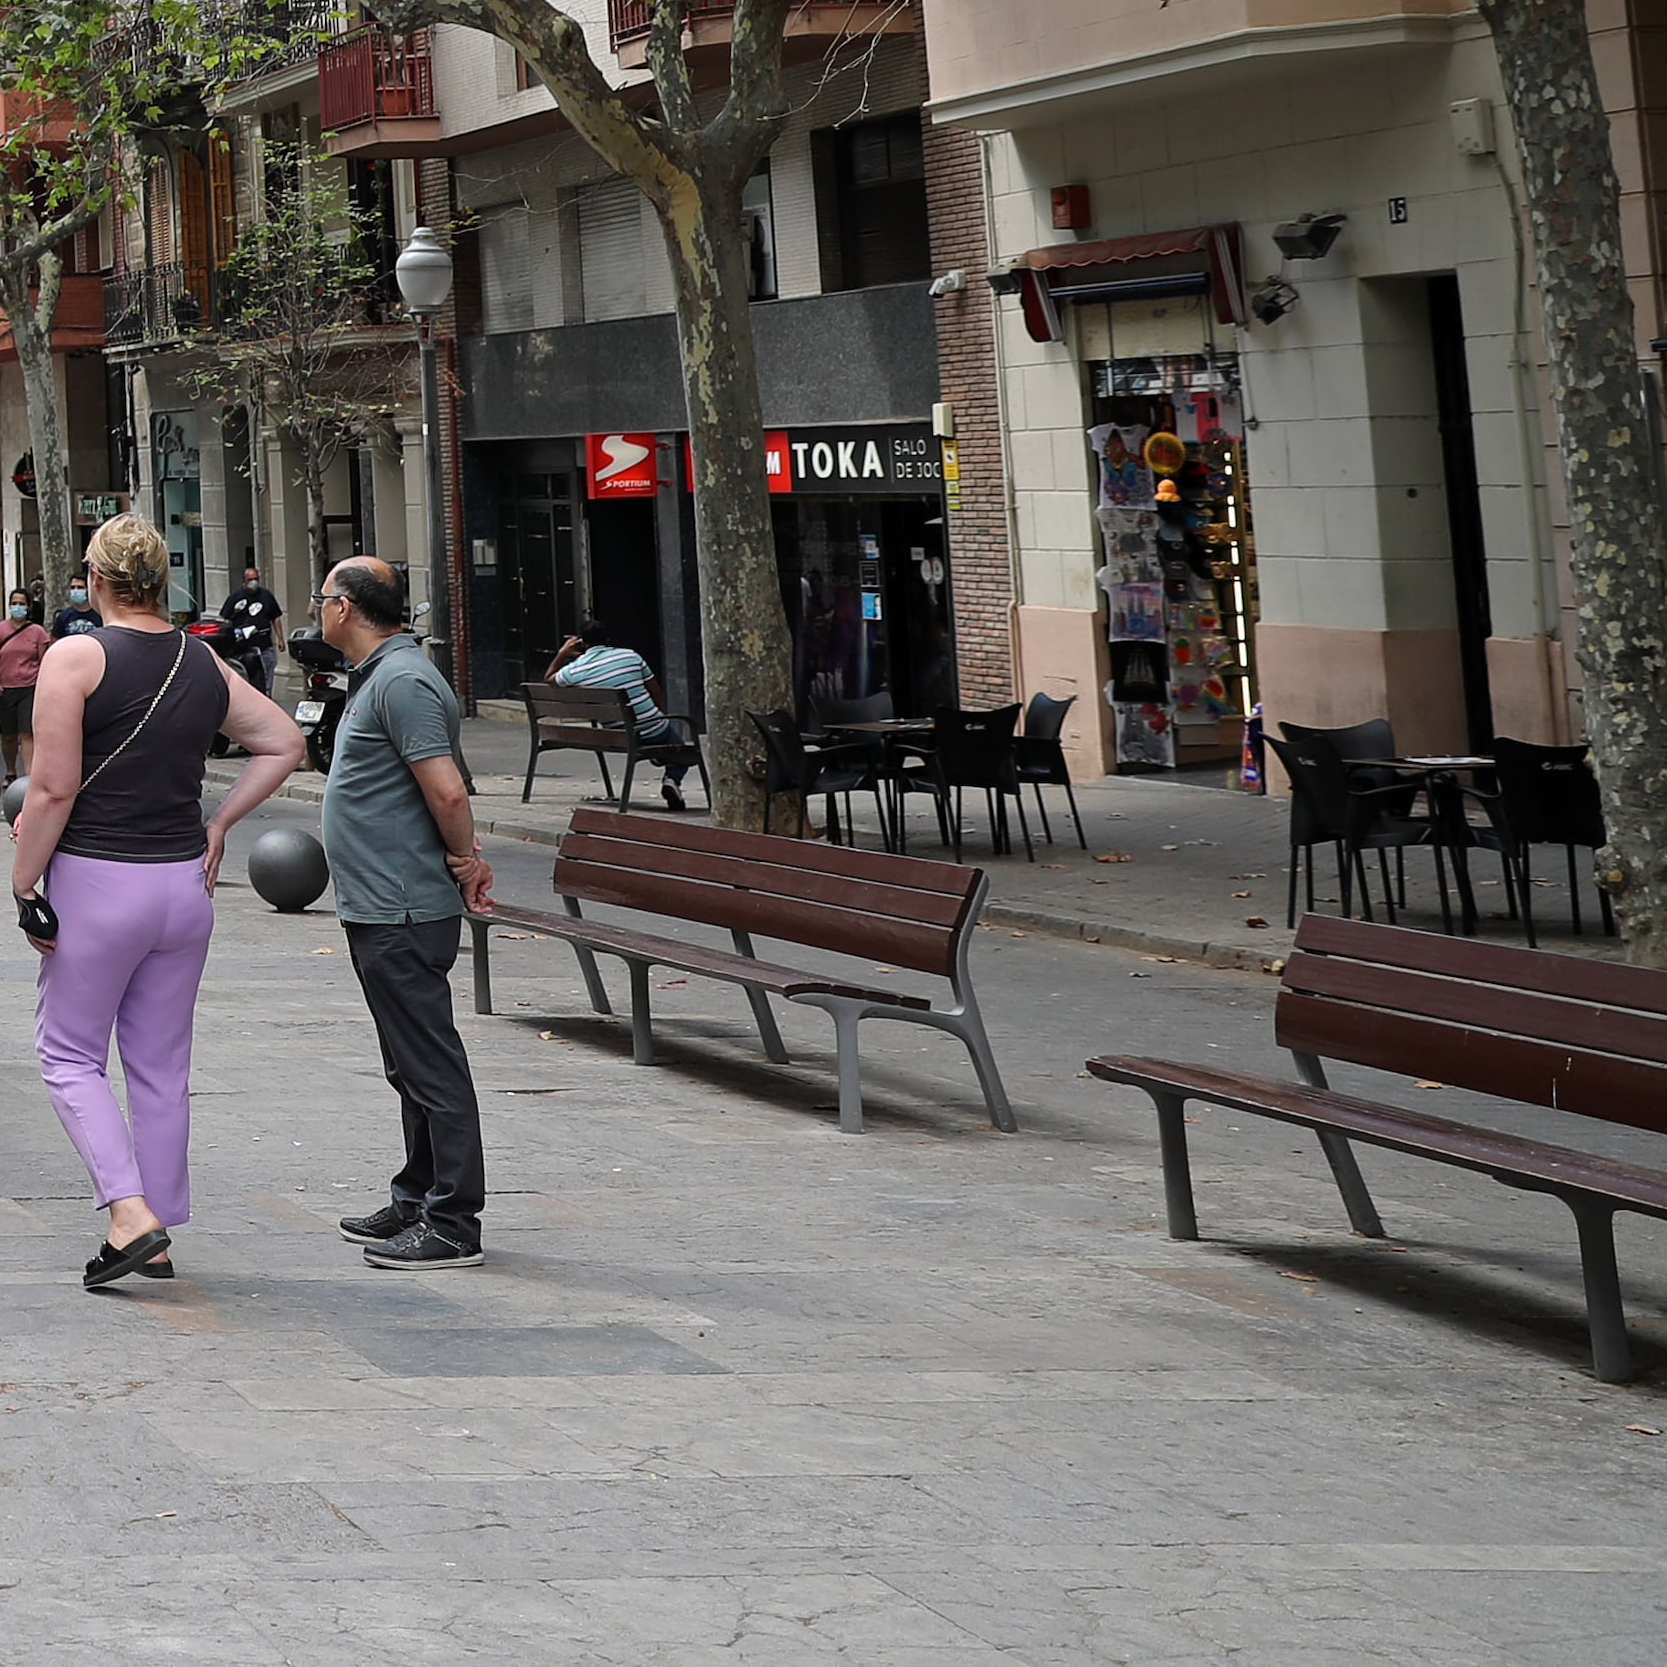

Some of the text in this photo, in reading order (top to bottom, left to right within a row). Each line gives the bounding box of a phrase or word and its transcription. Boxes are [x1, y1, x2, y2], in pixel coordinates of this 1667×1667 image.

[1390, 199, 1406, 221] 15
[894, 436, 928, 456] SALÓ
[791, 440, 884, 479] TOKA
[896, 462, 912, 479] DE
[600, 479, 651, 491] SPORTIUM
